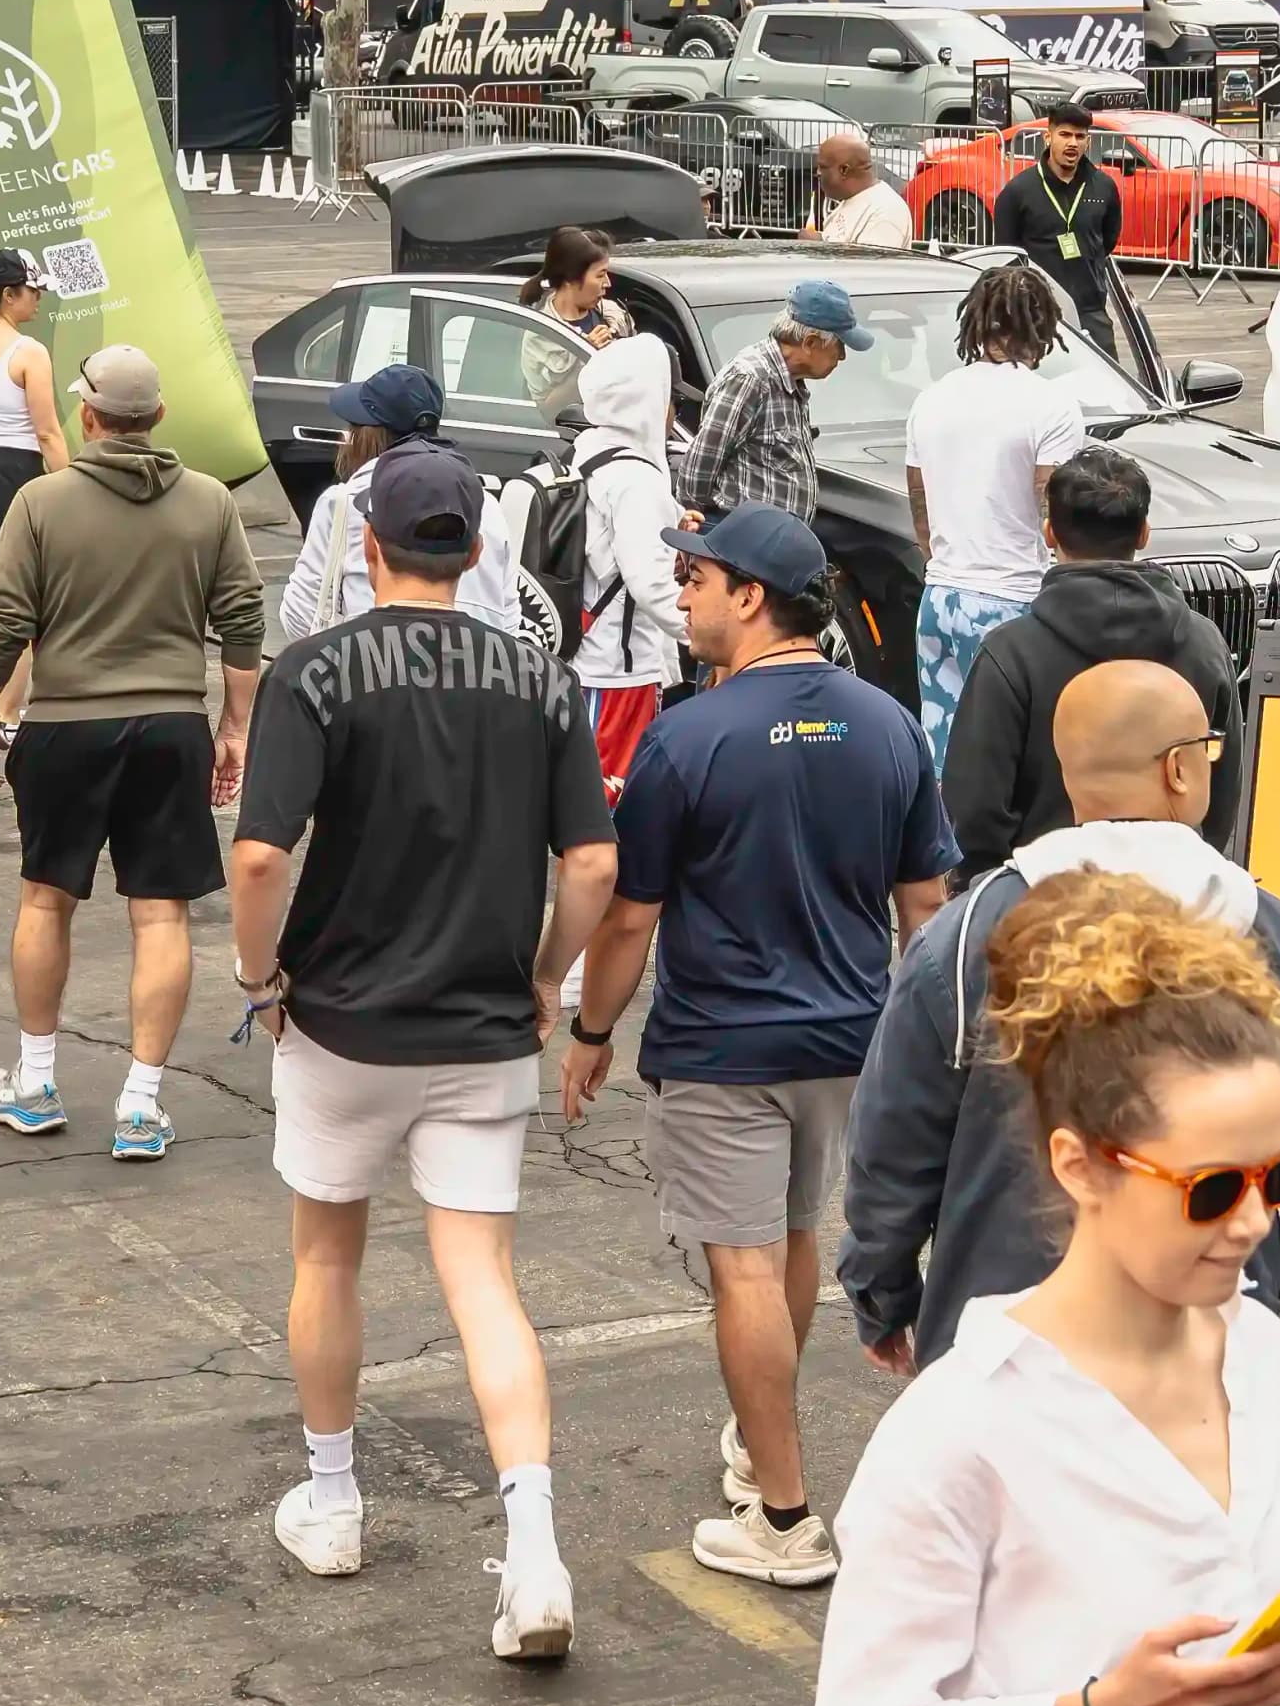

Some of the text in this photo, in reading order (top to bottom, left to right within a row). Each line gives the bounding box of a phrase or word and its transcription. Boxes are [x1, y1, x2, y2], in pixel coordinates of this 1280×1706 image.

[1100, 92, 1137, 107] TOYOTA
[6, 194, 98, 224] Let's find your
[1, 221, 53, 243] perfect
[48, 307, 73, 324] Find
[298, 621, 573, 734] GYMSHARK
[795, 719, 849, 735] demodays
